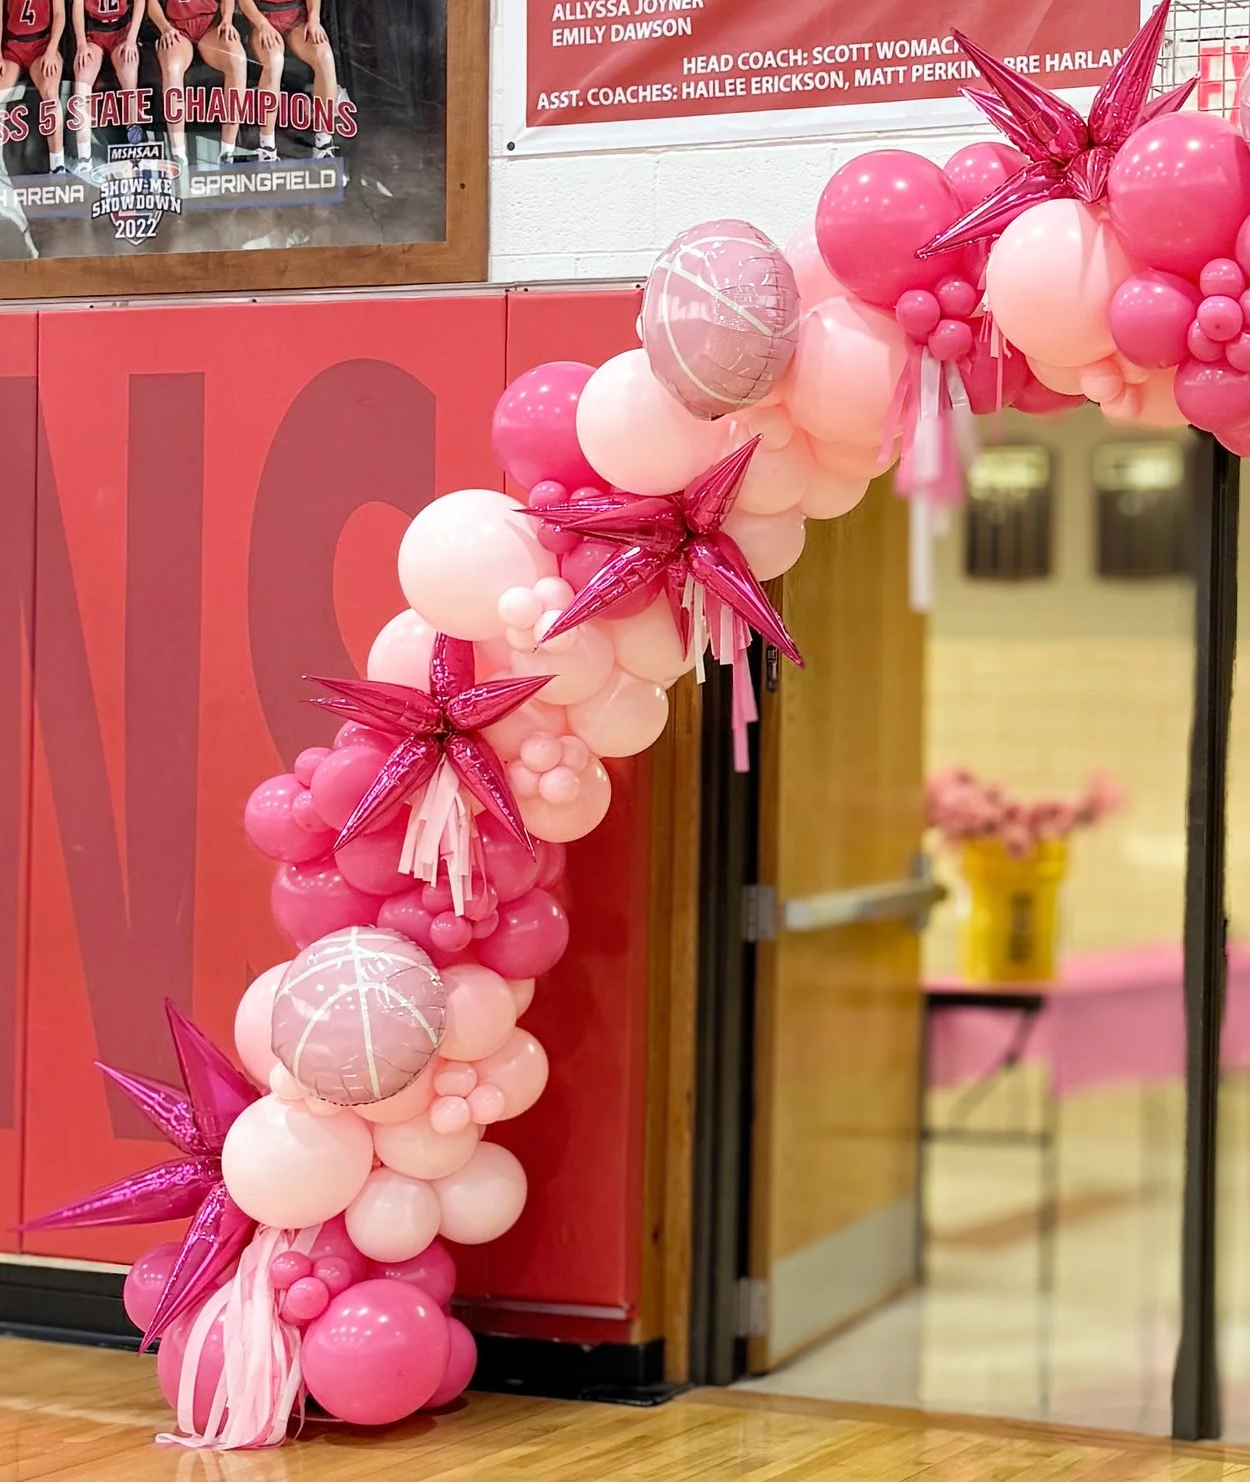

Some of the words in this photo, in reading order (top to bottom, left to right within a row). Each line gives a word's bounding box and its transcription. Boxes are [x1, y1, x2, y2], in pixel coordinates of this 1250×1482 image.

[552, 25, 607, 47] EMILY
[610, 16, 692, 43] DAWSON
[682, 54, 734, 76] HEAD
[737, 48, 809, 71] COACH:
[812, 42, 873, 65] SCOTT
[537, 89, 584, 111] ASST.
[586, 82, 678, 107] COACHES:
[681, 77, 747, 100] HAILEE
[751, 70, 850, 96] ERICKSON,
[854, 65, 907, 88] MATT
[911, 59, 981, 83] PERKIN
[38, 99, 58, 136] 5
[66, 87, 153, 132] STATE
[162, 85, 358, 139] CHAMPIONS
[111, 146, 160, 160] MSHSAA
[100, 178, 173, 198] SHOW-ME
[190, 169, 337, 196] SPRINGFIELD
[13, 184, 85, 207] ARENA
[91, 194, 182, 218] SHOWDOWN
[114, 218, 157, 239] 2022
